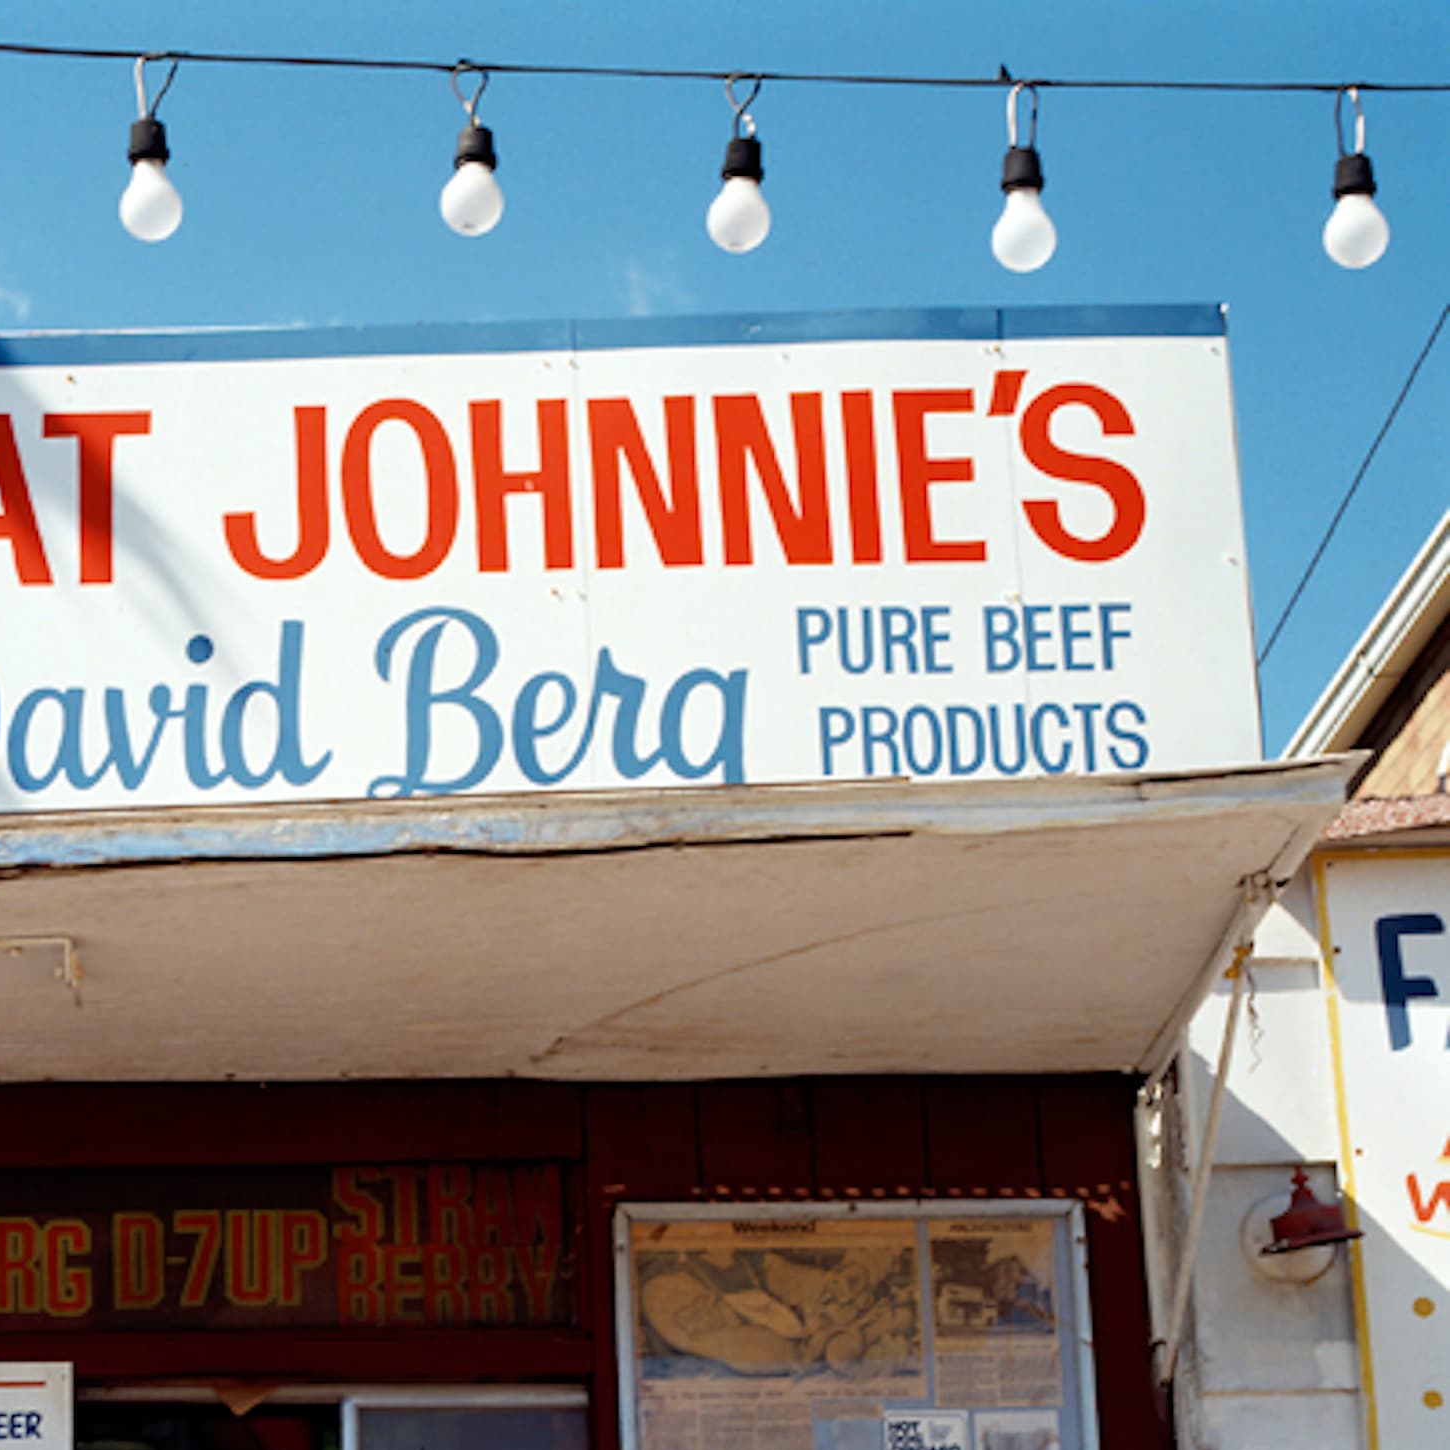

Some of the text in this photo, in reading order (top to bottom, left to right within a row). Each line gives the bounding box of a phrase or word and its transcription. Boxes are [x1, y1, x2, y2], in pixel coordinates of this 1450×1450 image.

[222, 370, 1148, 580] JOHNNIE'S
[797, 602, 1131, 675] PURE BEEF
[819, 702, 1149, 778] PRODUCTS
[332, 1164, 561, 1246] STRAW
[113, 1209, 328, 1310] D-7UP
[337, 1243, 561, 1328] BERRY
[888, 1420, 920, 1433] HOT
